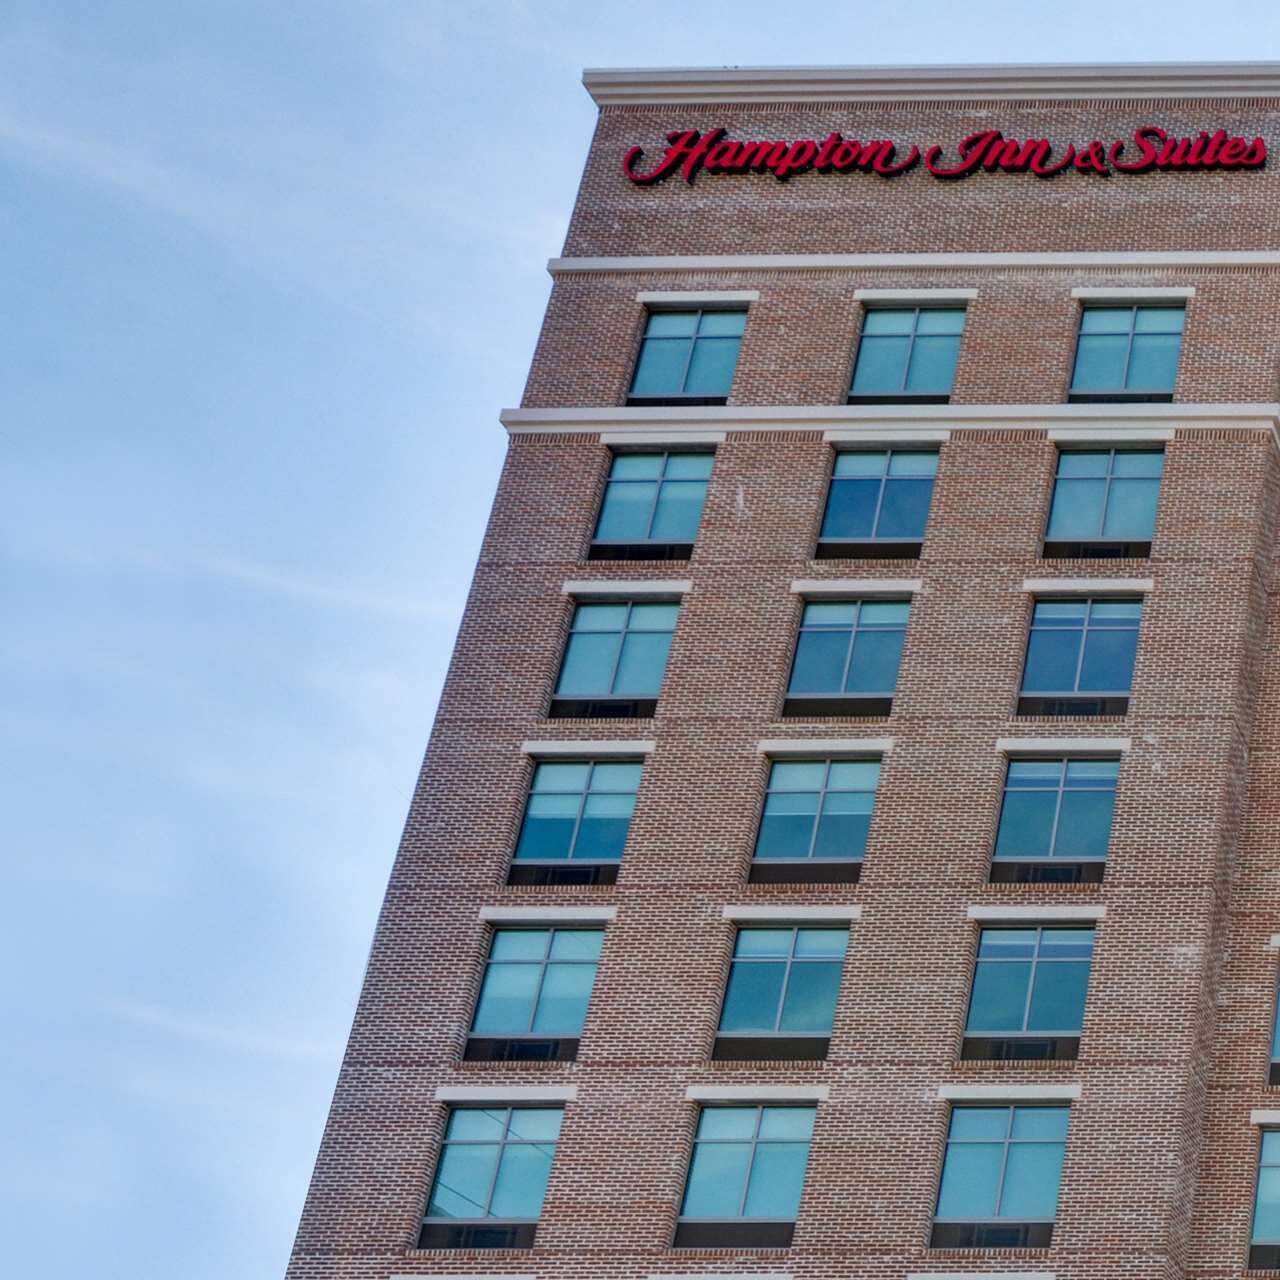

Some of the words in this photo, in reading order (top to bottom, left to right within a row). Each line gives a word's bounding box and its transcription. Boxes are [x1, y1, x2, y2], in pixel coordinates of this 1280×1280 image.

[623, 127, 920, 185] Hampton
[924, 129, 1077, 178] Inn
[1073, 140, 1111, 177] &
[1108, 126, 1267, 173] Suites
